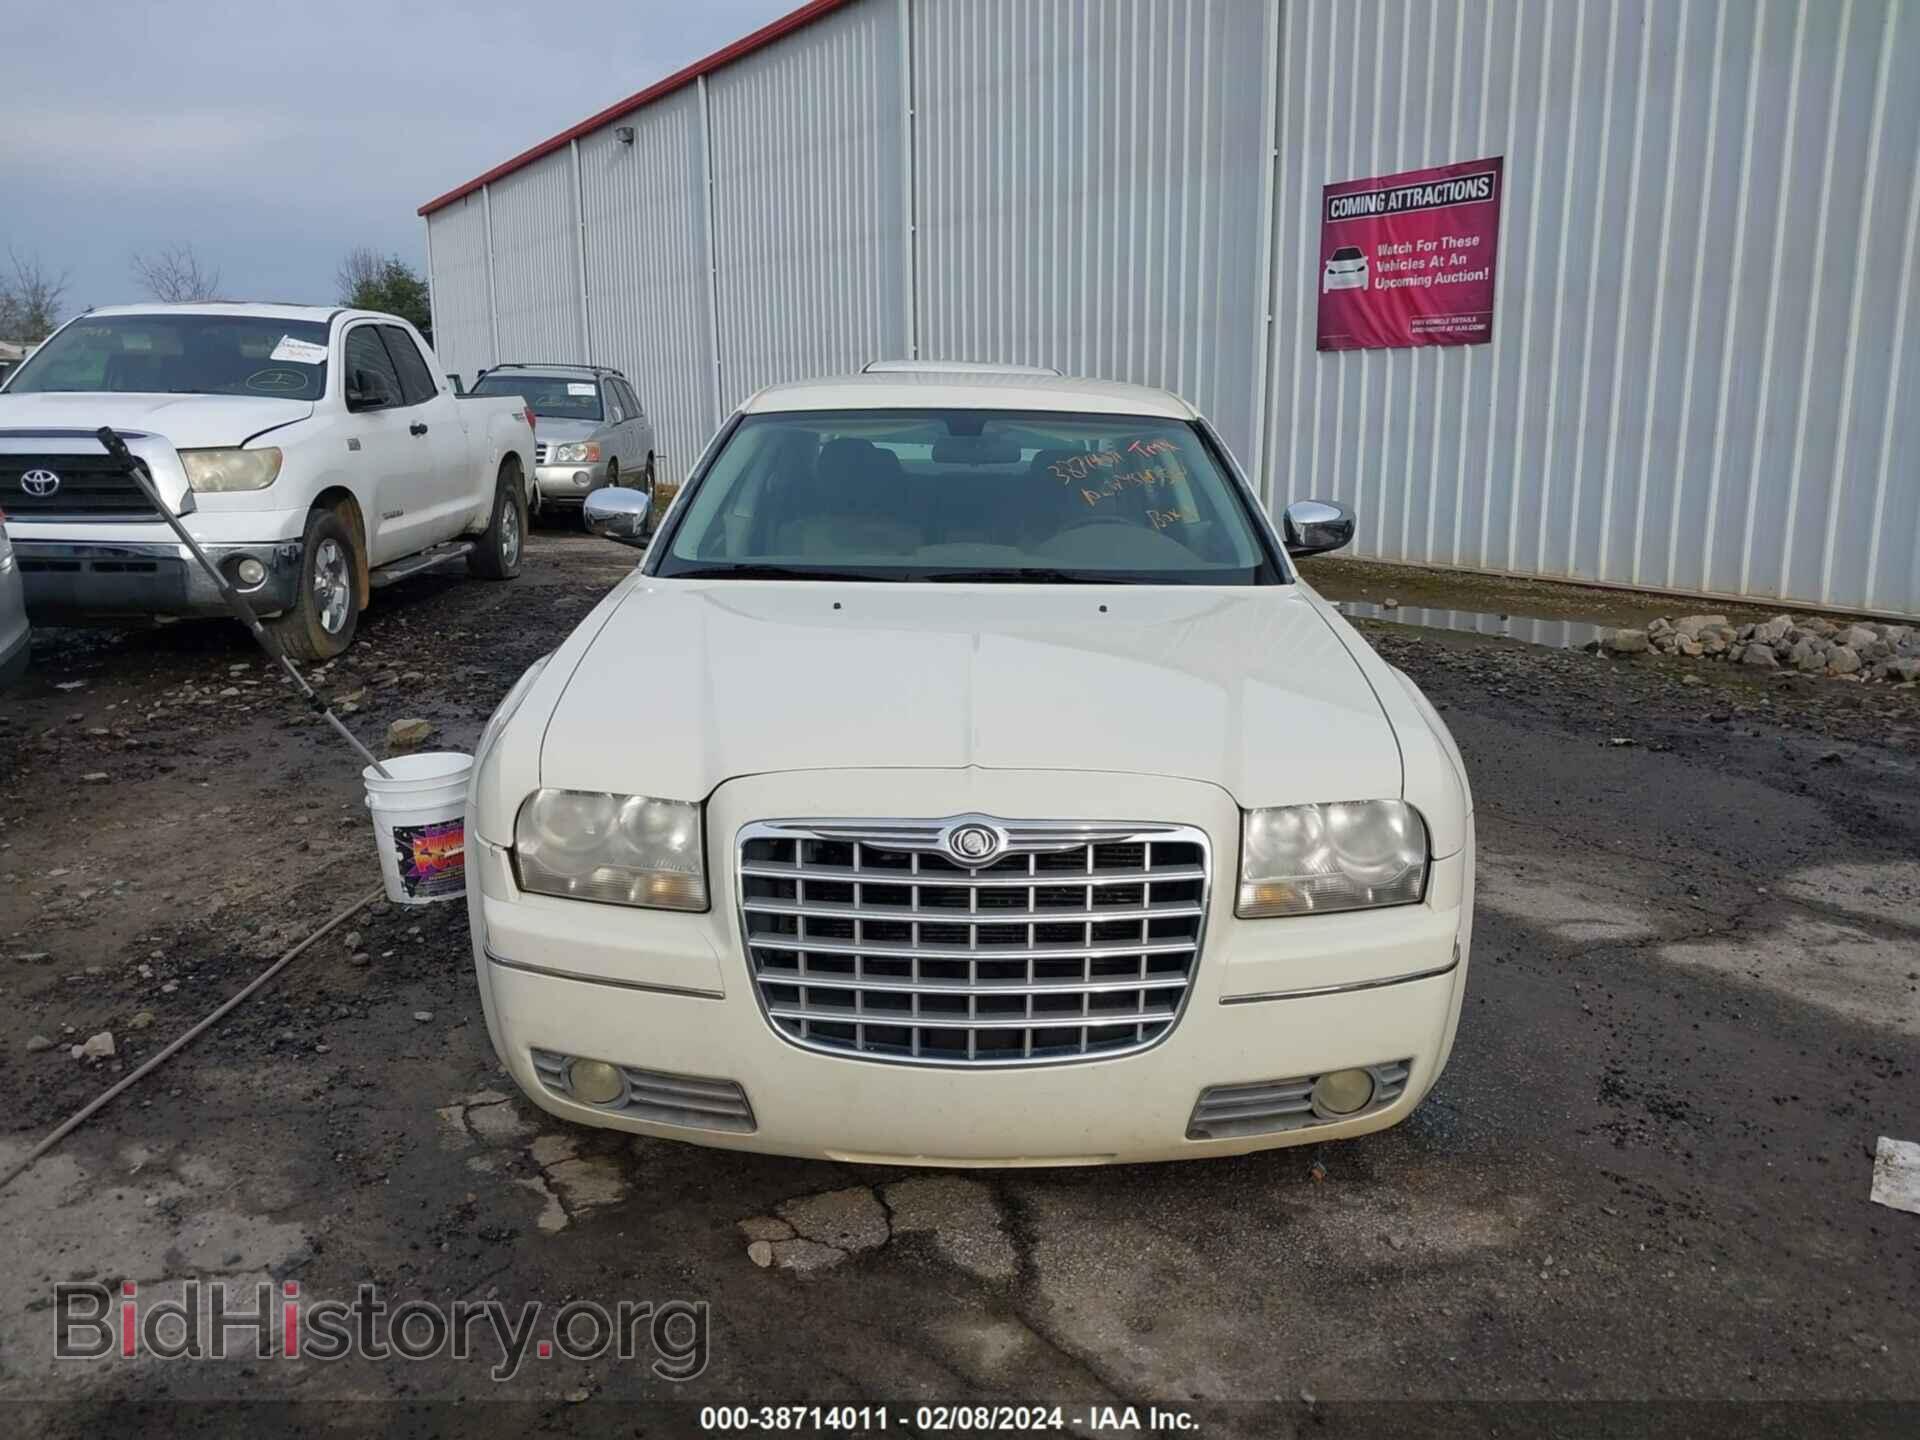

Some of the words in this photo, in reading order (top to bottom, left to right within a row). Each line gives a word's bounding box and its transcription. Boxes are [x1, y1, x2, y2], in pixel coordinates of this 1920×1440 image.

[1331, 193, 1386, 217] COMING
[1388, 177, 1489, 210] ATTRACTIONS
[1377, 242, 1412, 256] Watch
[1416, 239, 1438, 252] For
[1441, 236, 1480, 249] These
[1376, 258, 1425, 272] Vehicles
[1429, 255, 1444, 268] At
[1449, 253, 1467, 265] An
[1375, 275, 1432, 290] Upcoming
[1434, 267, 1489, 285] Auction!
